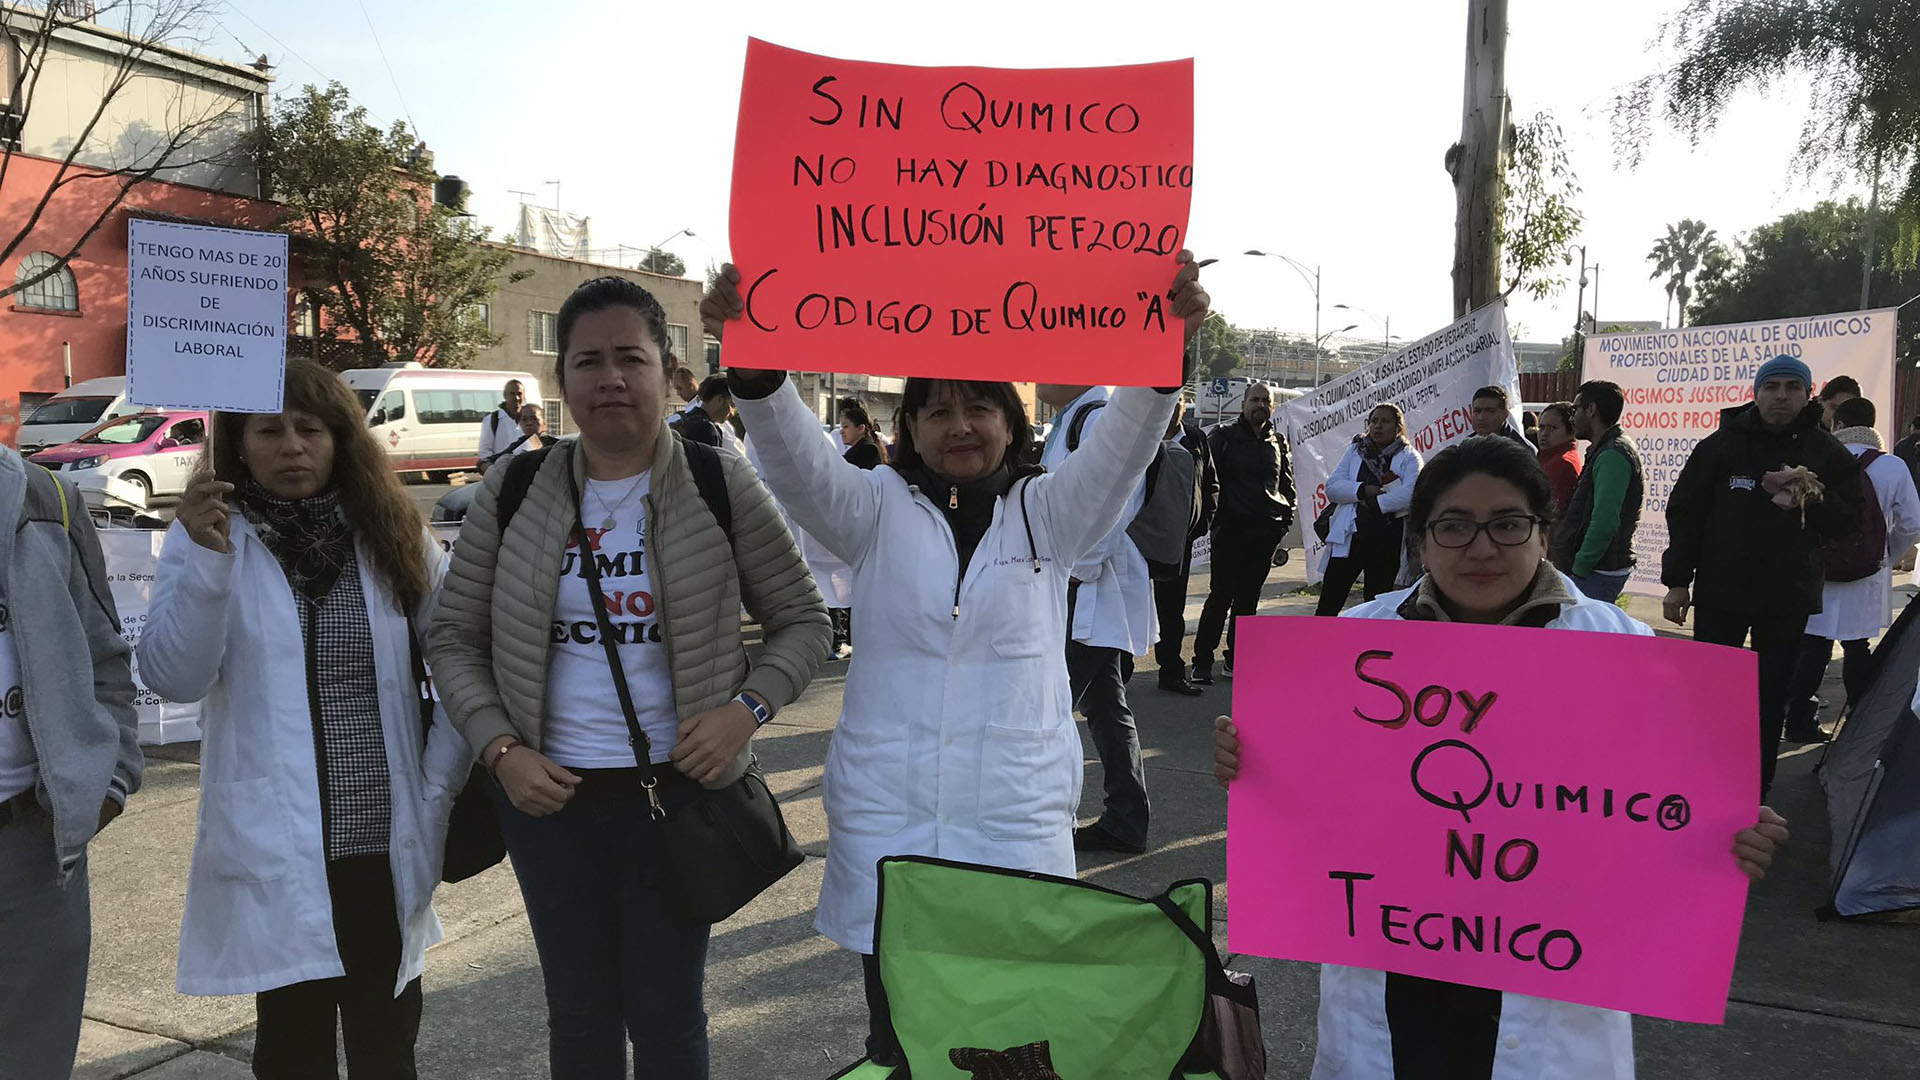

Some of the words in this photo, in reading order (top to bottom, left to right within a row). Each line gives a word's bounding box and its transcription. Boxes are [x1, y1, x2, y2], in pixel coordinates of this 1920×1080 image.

[809, 75, 903, 131] SIN
[941, 82, 1140, 134] QUIMICO
[793, 154, 856, 187] NO
[897, 157, 968, 187] HAY
[986, 160, 1193, 193] DIAGNOSTICO
[816, 202, 1004, 253] INCLUSIÓN
[1027, 214, 1180, 256] PEF2020
[137, 242, 194, 260] TENGO
[199, 248, 234, 264] MAS
[239, 252, 258, 266] DE
[263, 255, 281, 268] 20
[140, 265, 185, 283] AÑOS
[190, 271, 279, 291] SUFRIENDO
[200, 296, 221, 310] DE
[746, 268, 932, 333] CODIGO
[951, 308, 992, 336] DE
[1003, 281, 1126, 332] QUIMICO
[143, 314, 275, 337] DISCRIMINACIÓN
[1600, 335, 1679, 353] MOVIMIENTO
[1683, 327, 1757, 349] NACIONAL
[1761, 325, 1780, 342] DE
[1785, 316, 1871, 341] QUÍMICOS
[174, 340, 245, 358] LABORAL
[1409, 340, 1434, 366] ESTADO
[1435, 335, 1444, 352] DE
[1445, 318, 1479, 347] VERACRUZ
[1610, 348, 1707, 368] PROFESIONALES
[1712, 347, 1730, 364] DE
[1732, 346, 1750, 362] LA
[1657, 366, 1709, 383] CIUDAD
[1714, 364, 1731, 382] DE
[1735, 360, 1760, 380] MÉ
[1687, 384, 1755, 404] JUSTICIA
[1636, 434, 1664, 451] SÓLO
[1668, 438, 1703, 452] PROC
[1653, 469, 1666, 481] EN
[1650, 484, 1660, 497] EL
[117, 574, 126, 582] la
[1353, 649, 1498, 735] SOY
[1411, 739, 1691, 831] QUIMIC@
[1445, 829, 1539, 882] NO
[1328, 870, 1583, 972] TECNICO
